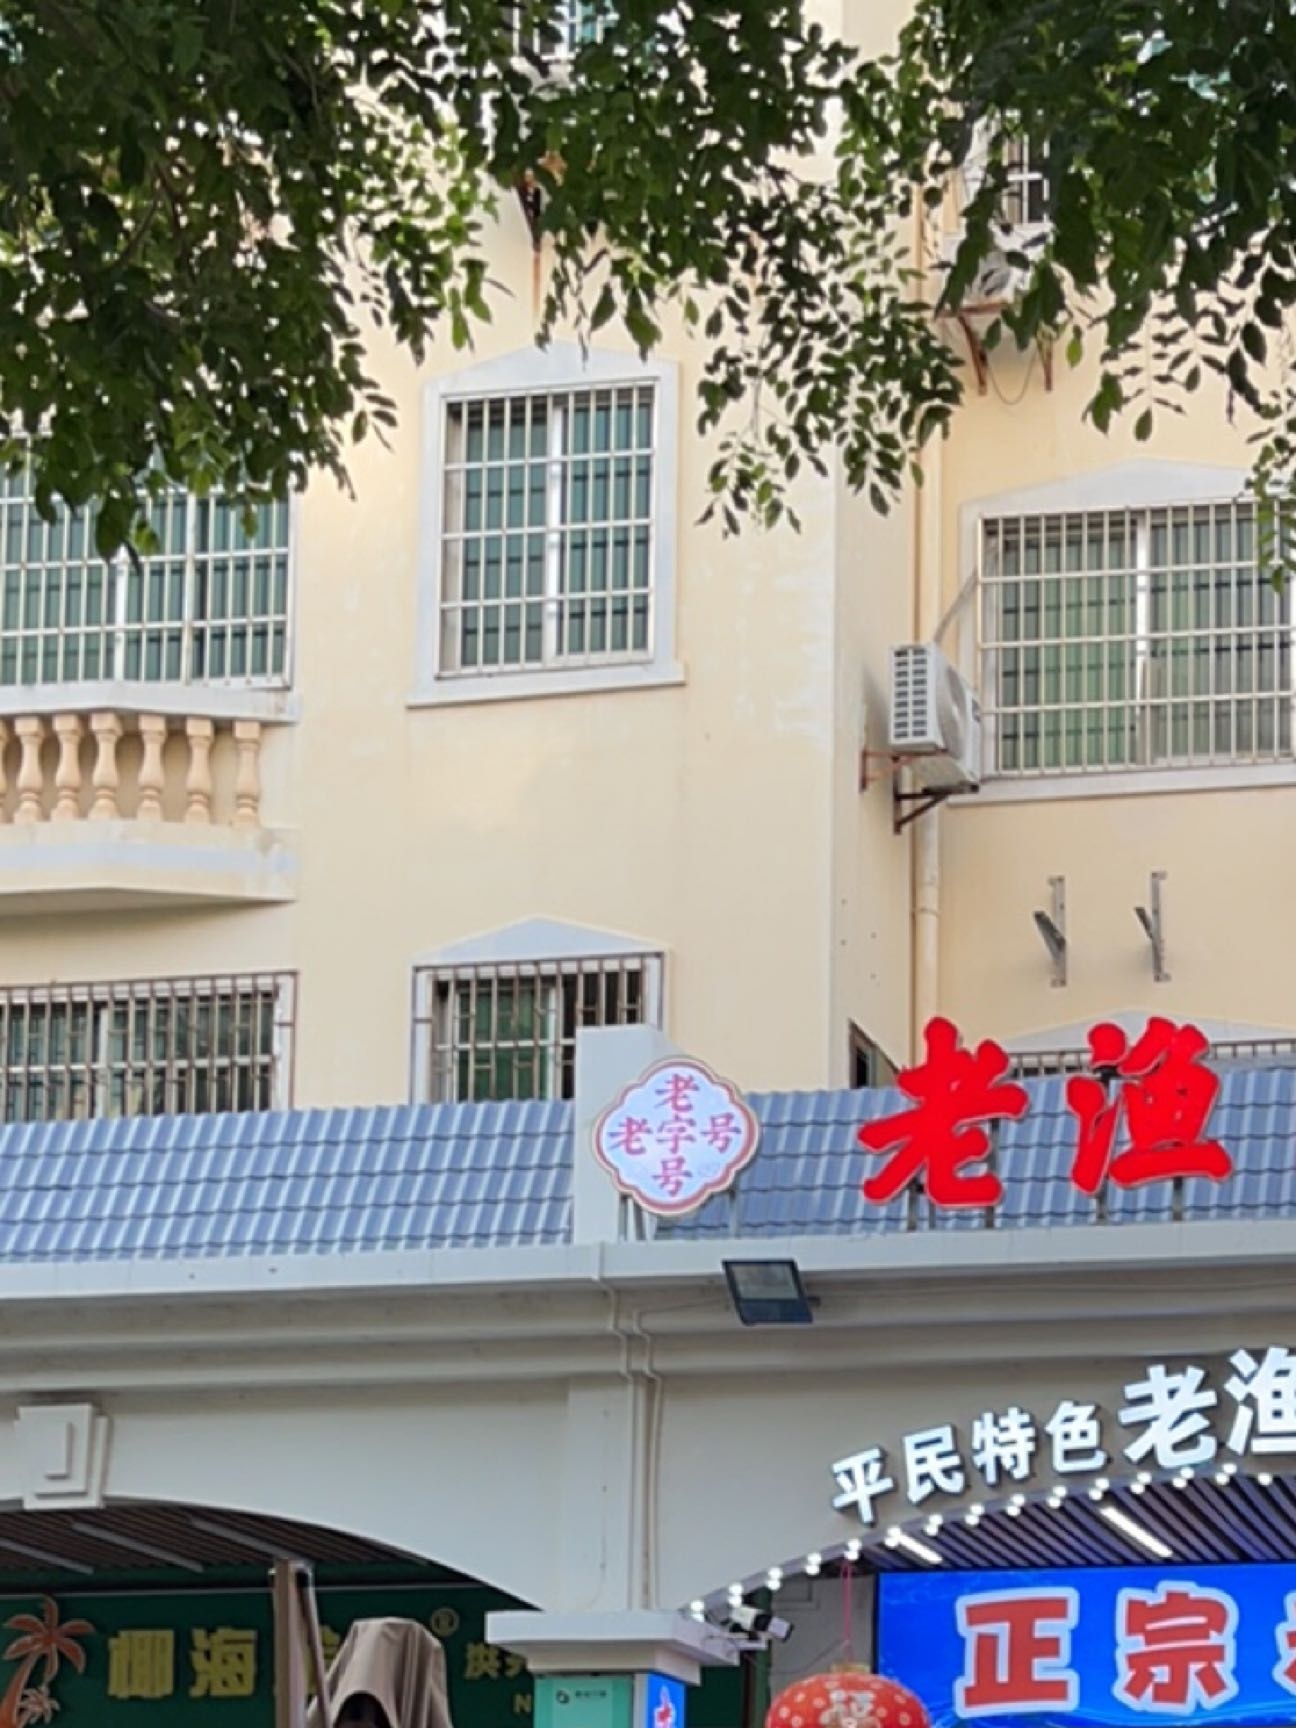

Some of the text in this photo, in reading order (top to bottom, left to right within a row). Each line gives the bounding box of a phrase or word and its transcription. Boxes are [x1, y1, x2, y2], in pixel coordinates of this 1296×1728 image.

[607, 1112, 742, 1155] 老字号
[653, 1073, 699, 1197] 老字号
[108, 1627, 342, 1697] 椰海
